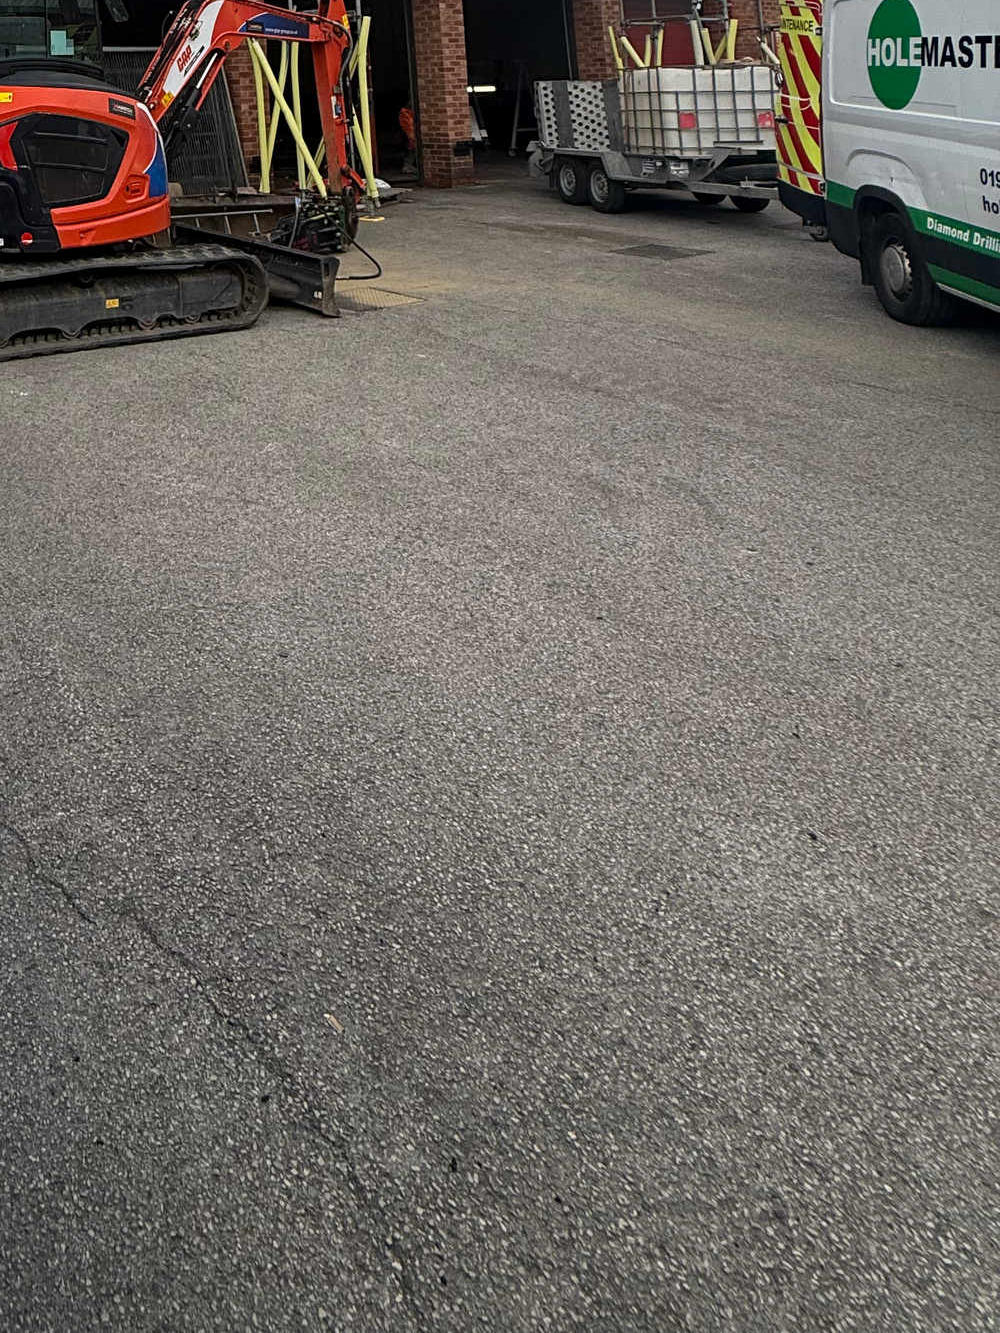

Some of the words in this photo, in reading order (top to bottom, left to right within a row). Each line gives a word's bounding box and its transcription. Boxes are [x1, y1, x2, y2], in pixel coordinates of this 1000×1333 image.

[780, 18, 814, 32] NTENANCE
[177, 45, 192, 73] GAP
[982, 195, 1000, 214] ho
[927, 217, 970, 242] Diamond
[973, 232, 1000, 254] Drilli
